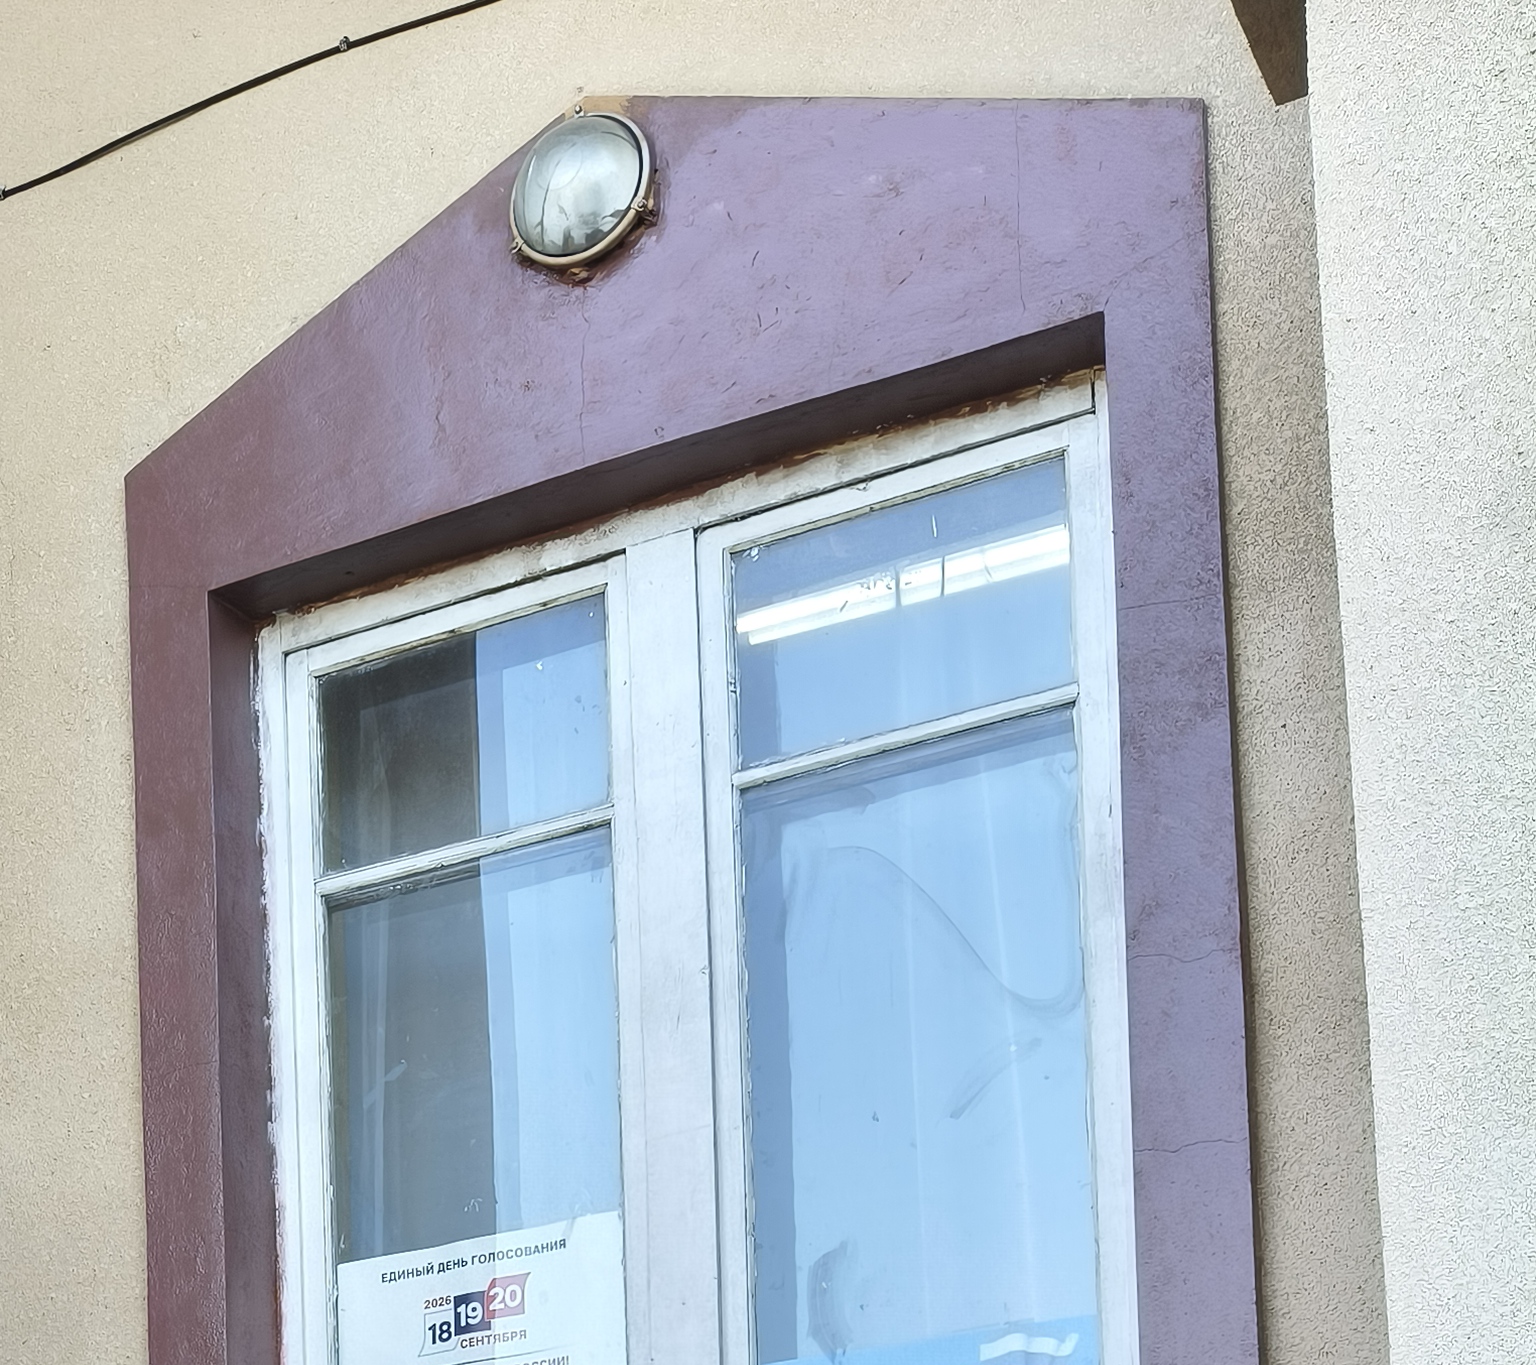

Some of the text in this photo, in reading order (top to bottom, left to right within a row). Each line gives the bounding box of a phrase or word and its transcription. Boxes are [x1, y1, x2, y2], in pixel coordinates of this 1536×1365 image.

[381, 1238, 566, 1283] ЕДИНЫЙ ДЕНЬ ГОЛОСОВАНИЯ
[423, 1295, 452, 1310] 2026
[428, 1284, 523, 1345] 18 19 20
[460, 1329, 527, 1349] СЕНТЯБРЯ
